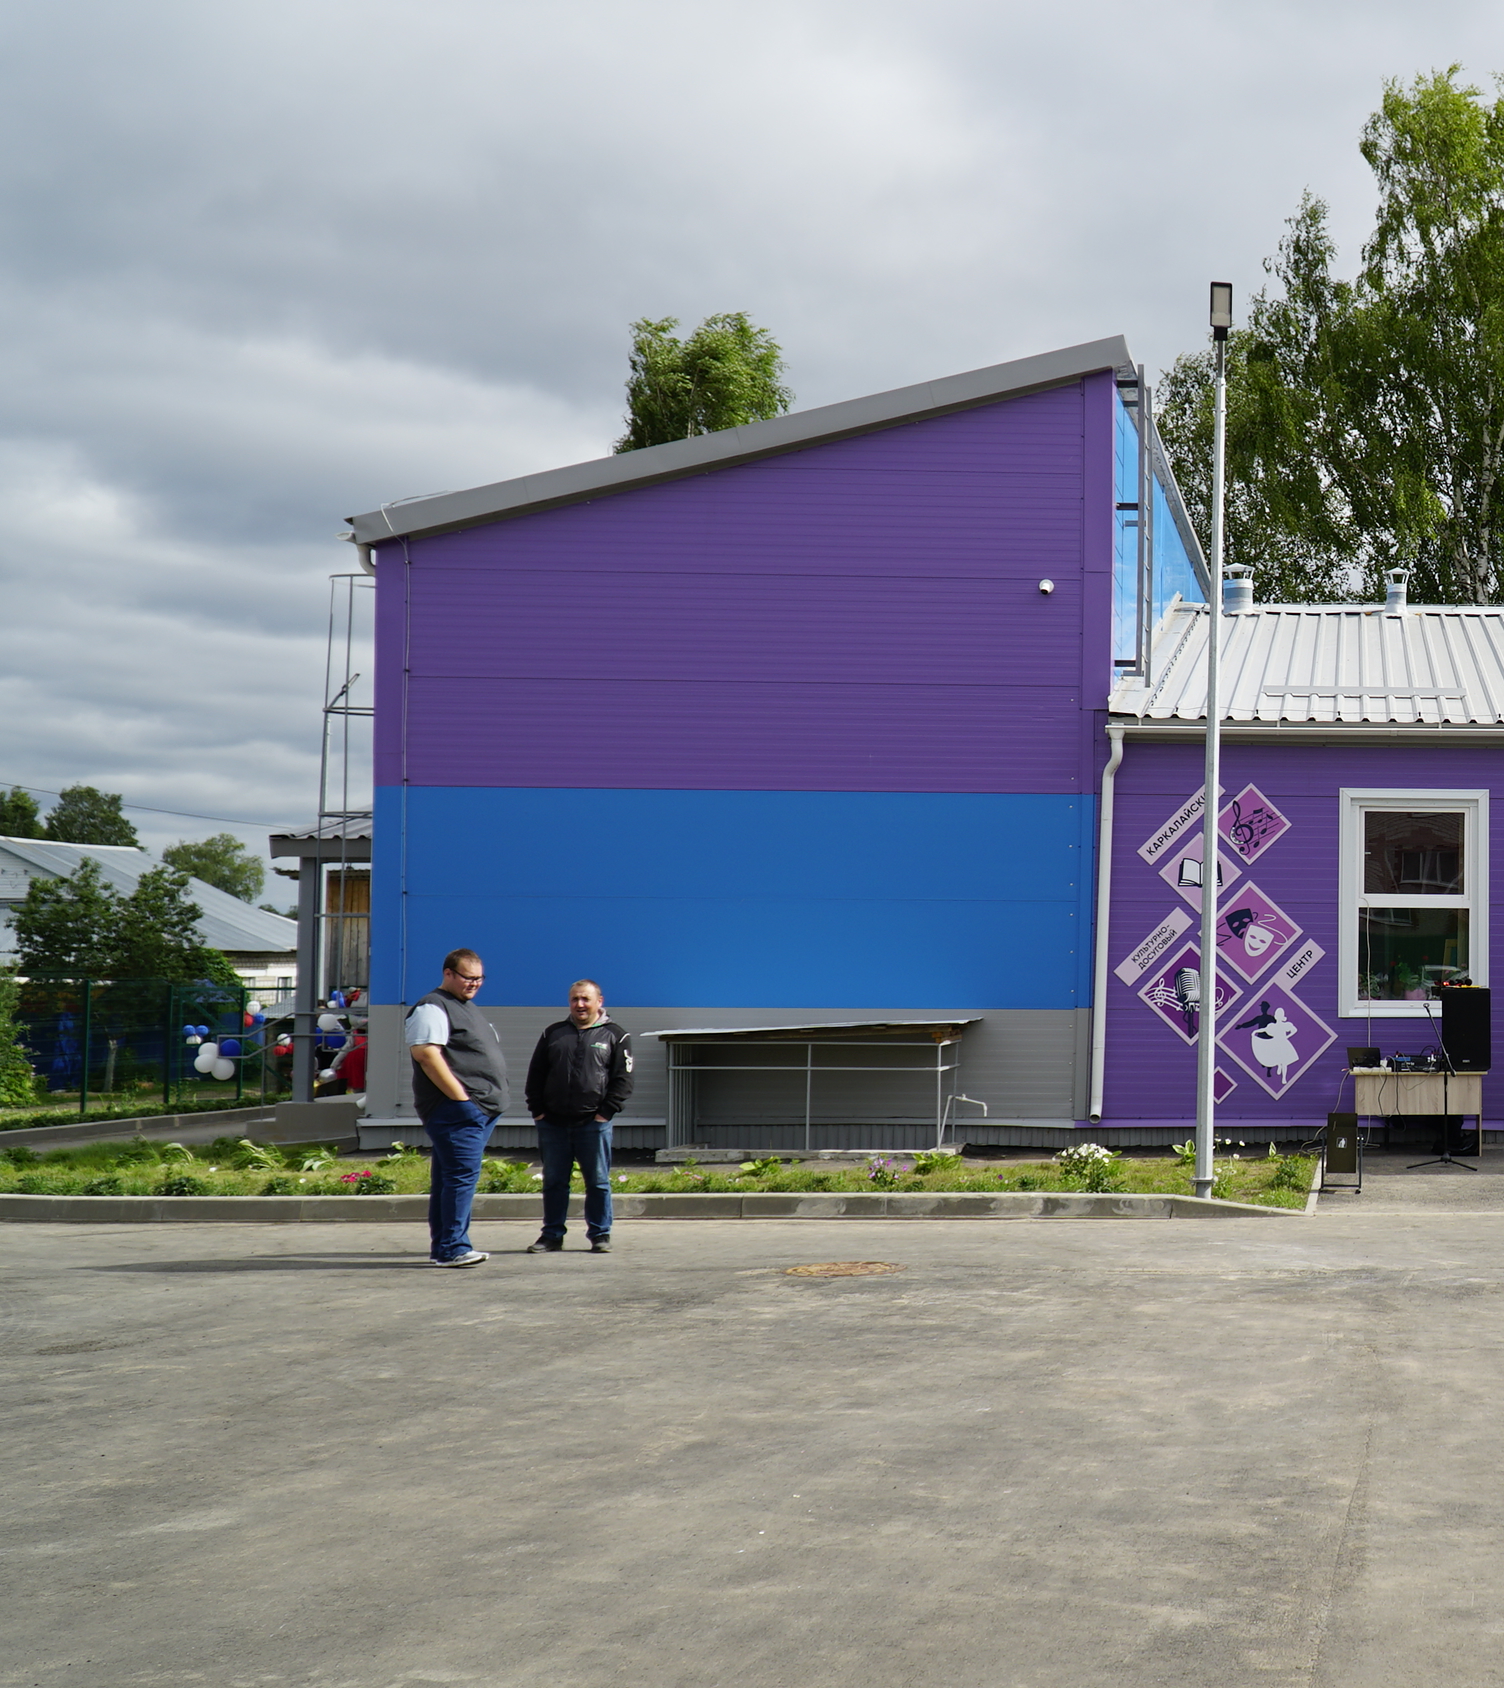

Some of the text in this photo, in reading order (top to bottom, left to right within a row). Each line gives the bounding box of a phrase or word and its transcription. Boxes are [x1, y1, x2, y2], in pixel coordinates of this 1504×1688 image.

[1146, 792, 1206, 856] КАРКАЛАЙСК
[1131, 924, 1170, 963] КУЛЬТУРНО-
[1138, 929, 1178, 970] ДОСУГОВЫЙ
[1286, 950, 1313, 979] ЦЕНТР
